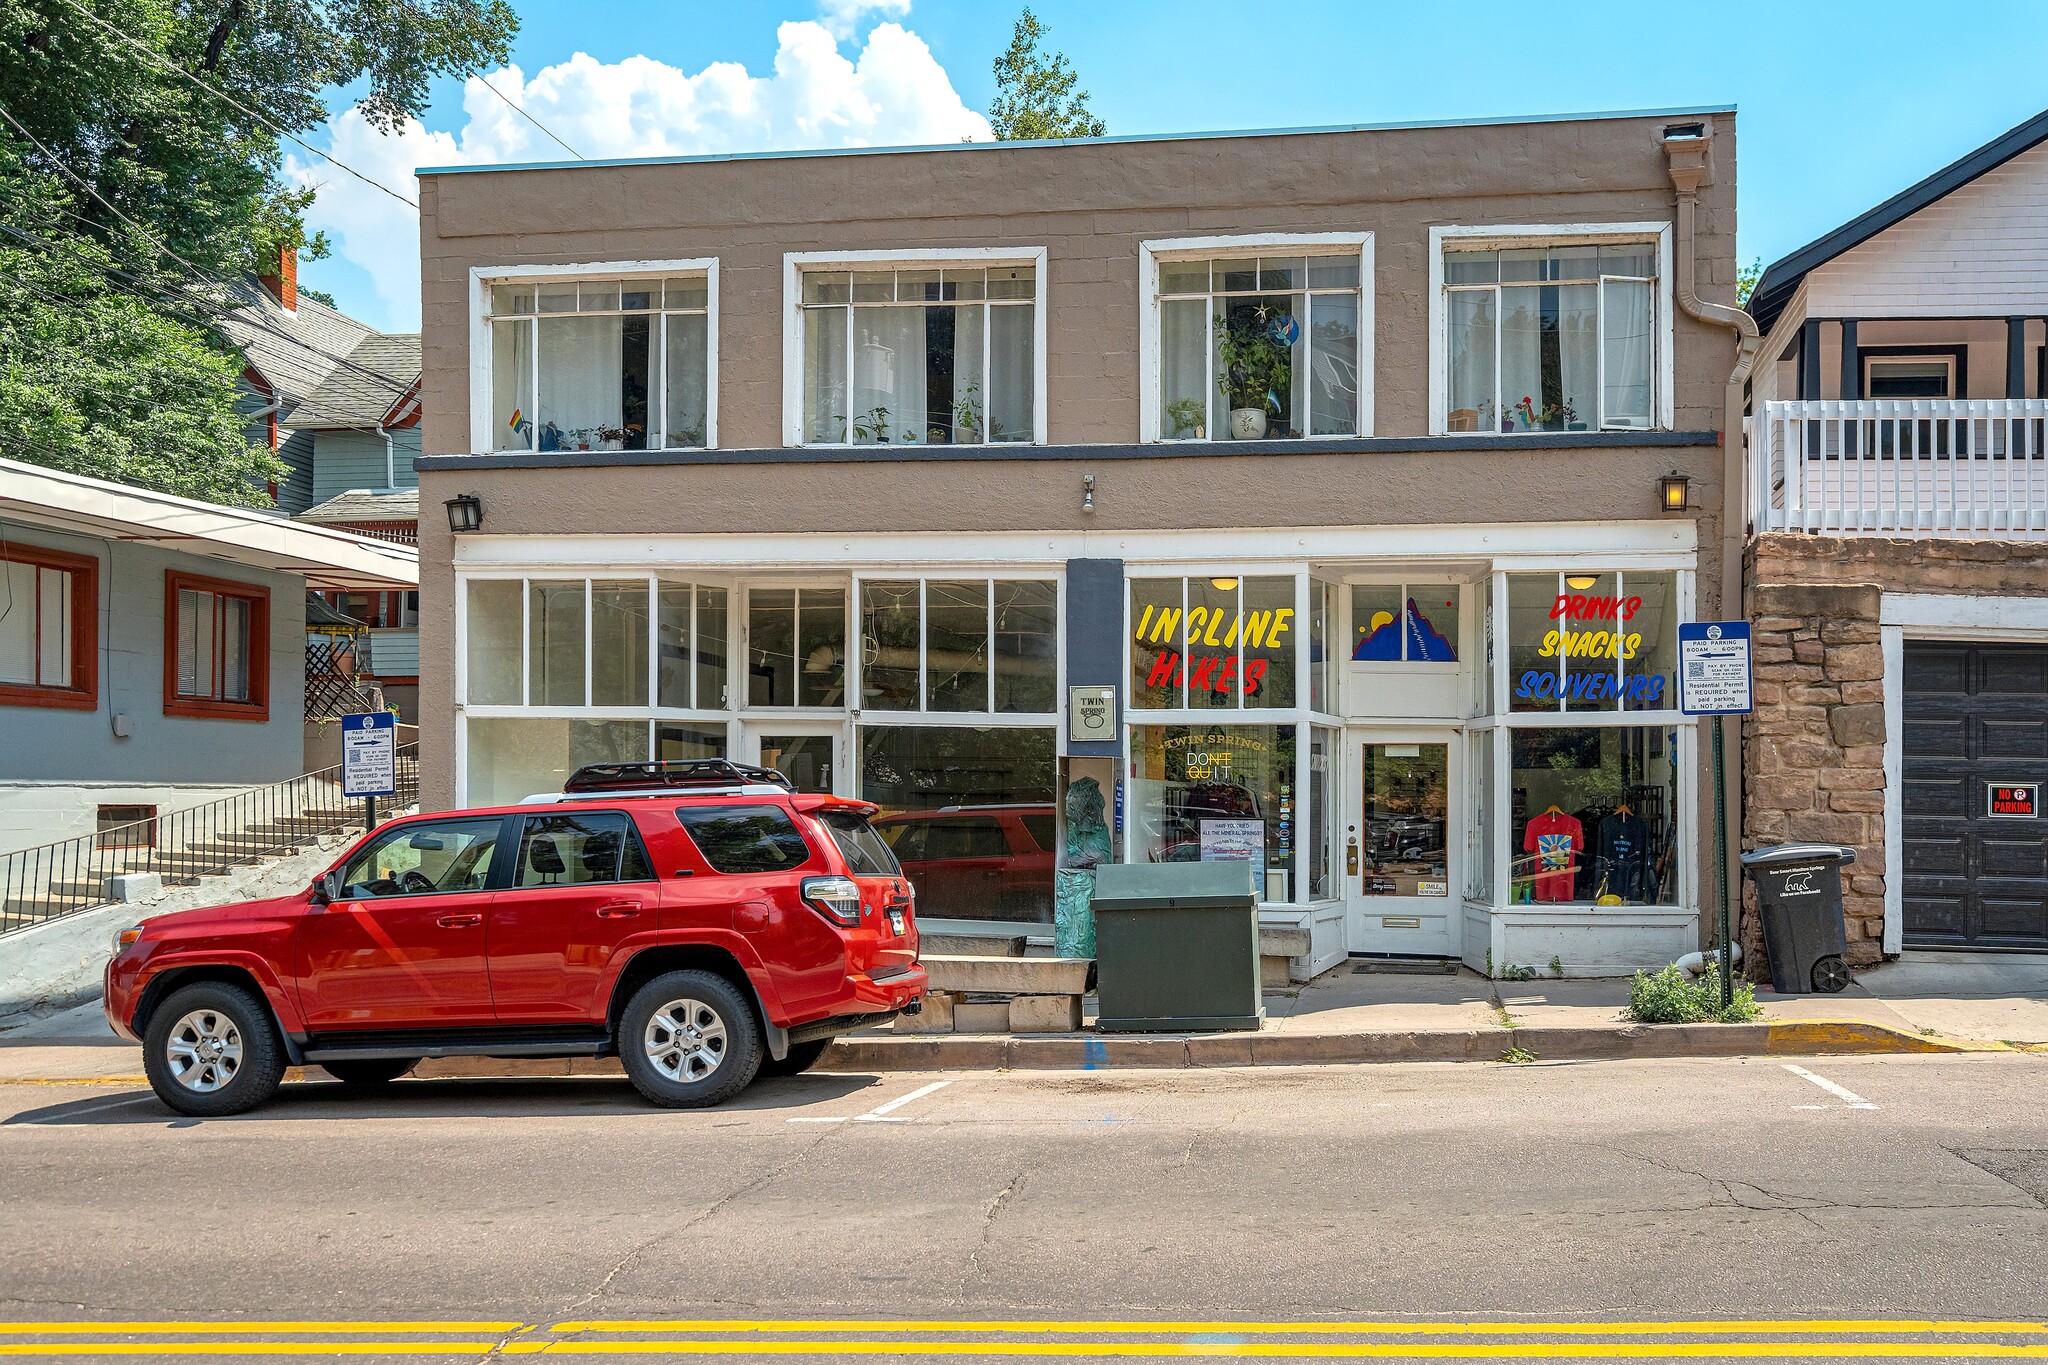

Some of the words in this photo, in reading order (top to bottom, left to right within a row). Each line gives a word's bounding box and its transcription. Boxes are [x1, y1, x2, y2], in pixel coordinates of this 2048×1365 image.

[1548, 594, 1643, 621] DRINKS
[1135, 604, 1294, 649] INCLINE
[1537, 629, 1642, 660] SNACKS
[1146, 651, 1268, 695] HIKES
[1515, 670, 1667, 700] SOUVENIRS
[1080, 697, 1105, 705] TWIN
[1080, 707, 1106, 715] SPRING
[1164, 734, 1204, 749] TWIN
[1207, 734, 1262, 751] SPRING
[1187, 752, 1232, 766] DON'T
[1998, 788, 2011, 800] NO
[1994, 801, 2032, 813] PARKING
[1169, 899, 1175, 907] 9
